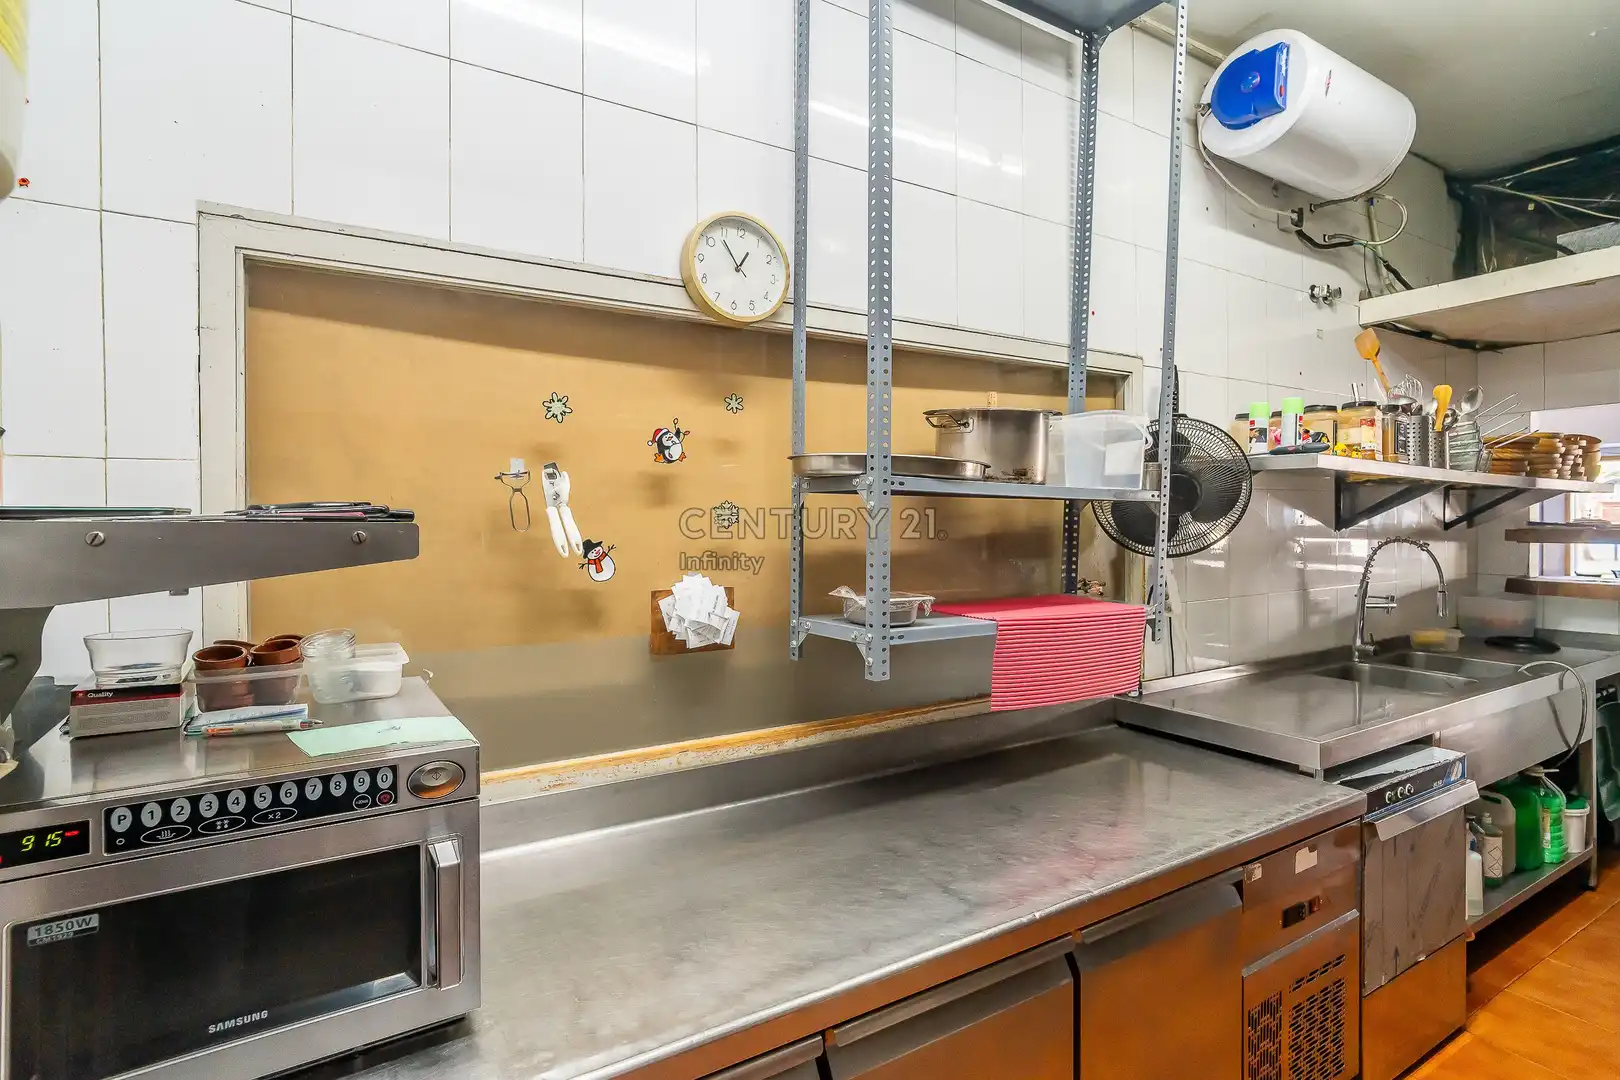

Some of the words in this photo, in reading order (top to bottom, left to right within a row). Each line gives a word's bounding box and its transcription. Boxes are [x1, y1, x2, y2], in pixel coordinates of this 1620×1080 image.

[720, 226, 728, 239] 11
[736, 226, 747, 239] 12
[705, 235, 716, 247] 10
[756, 238, 760, 249] 1
[697, 252, 705, 263] 9
[766, 254, 773, 265] 2
[701, 272, 708, 284] 8
[770, 274, 776, 285] 3
[714, 291, 721, 302] 7
[763, 291, 769, 300] 4
[730, 300, 738, 311] 6
[748, 300, 756, 312] 5
[358, 777, 366, 787] 9
[380, 773, 388, 784] 0
[309, 784, 317, 795] 7
[334, 780, 342, 791] 8
[259, 792, 267, 803] 5
[284, 788, 293, 799] 6
[204, 801, 213, 812] 3
[231, 796, 240, 807] 4
[148, 810, 154, 821] 1
[176, 805, 185, 816] 2
[117, 814, 127, 826] P
[35, 917, 92, 937] 1850W
[208, 1010, 268, 1034] SAMSUNG
